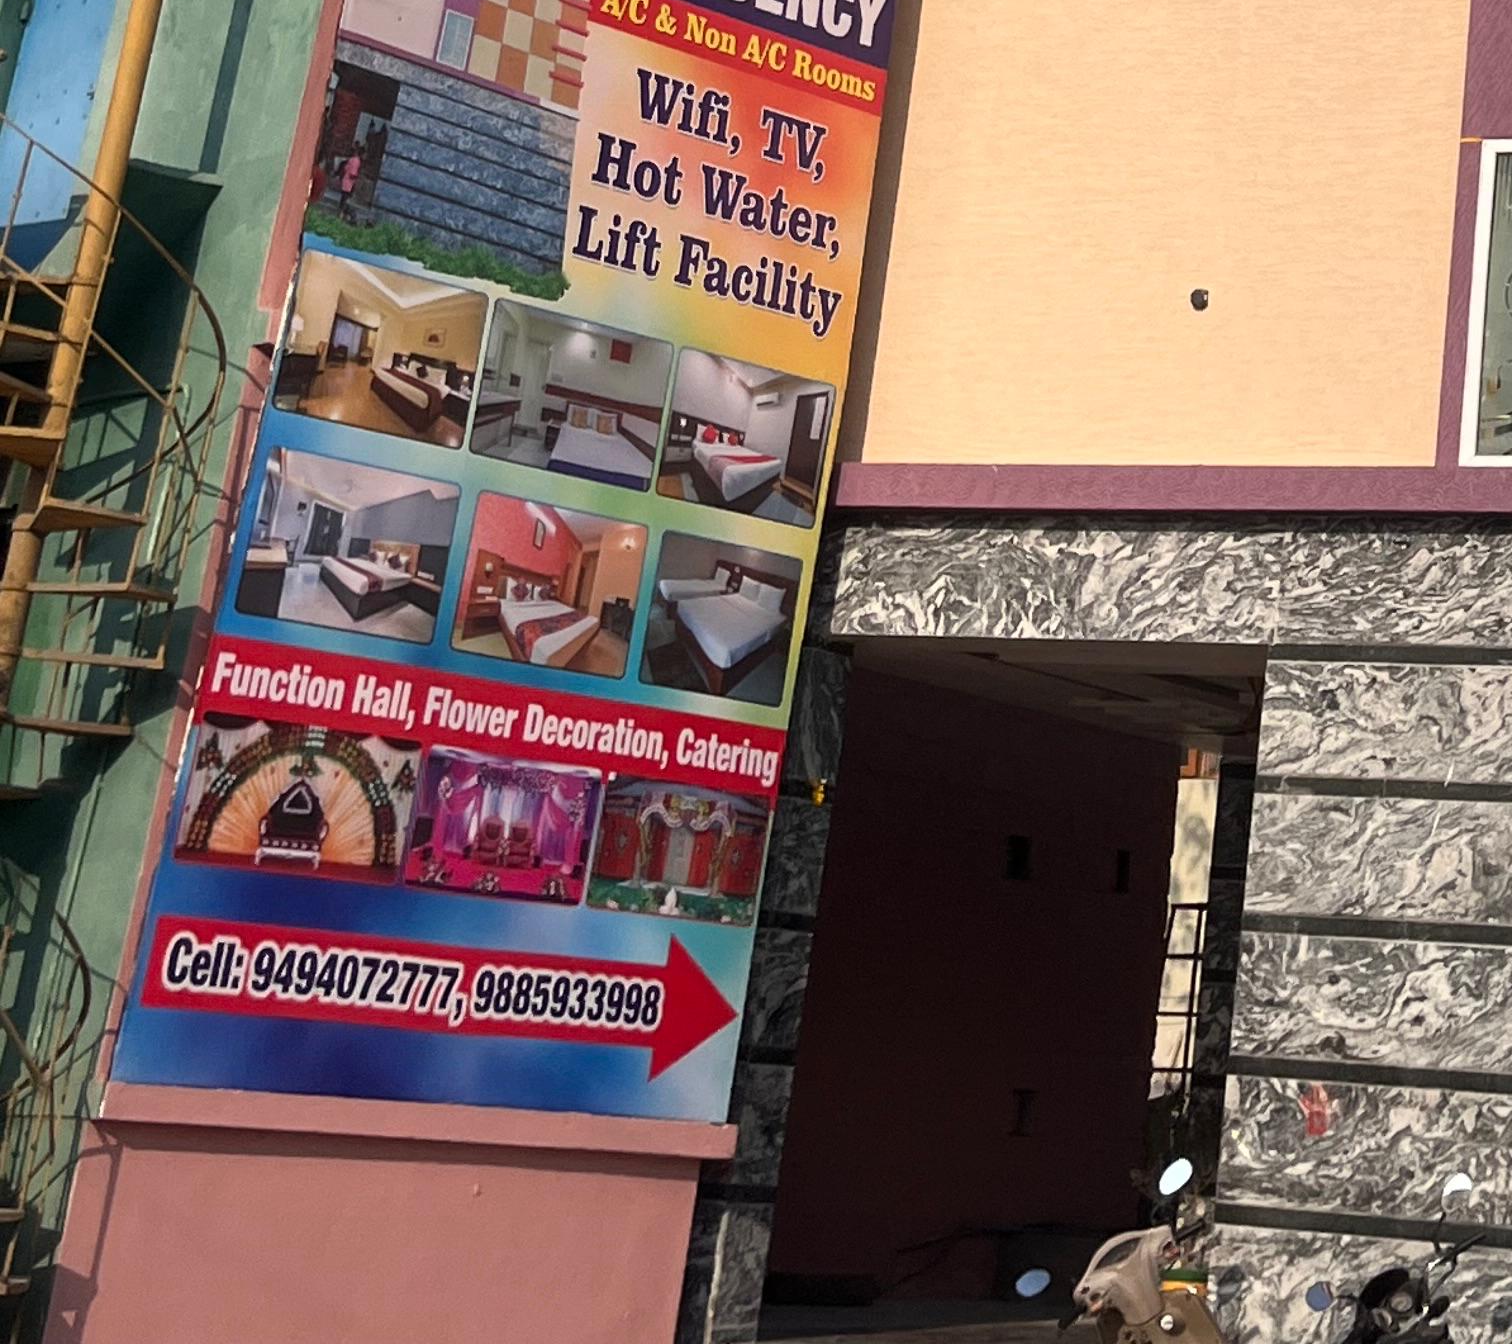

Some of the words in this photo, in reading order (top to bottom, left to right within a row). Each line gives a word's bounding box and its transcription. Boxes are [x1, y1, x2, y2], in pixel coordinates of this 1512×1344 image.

[654, 3, 678, 37] &
[683, 12, 738, 56] Non
[742, 30, 788, 72] A/C
[791, 50, 877, 103] Rooms
[636, 68, 741, 155] Wifi,
[761, 109, 827, 181] TV,
[591, 132, 683, 206] Hot
[702, 164, 840, 260] Water,
[572, 205, 662, 277] Lift
[674, 234, 842, 338] Facility
[211, 651, 346, 711] Function
[351, 674, 416, 731] Hall,
[423, 685, 519, 739] Flower
[522, 703, 669, 770] Decoration,
[676, 728, 779, 789] Catering
[166, 936, 245, 990] Cell:
[250, 946, 463, 1022] 9494072777,
[473, 969, 662, 1027] 9885933998
